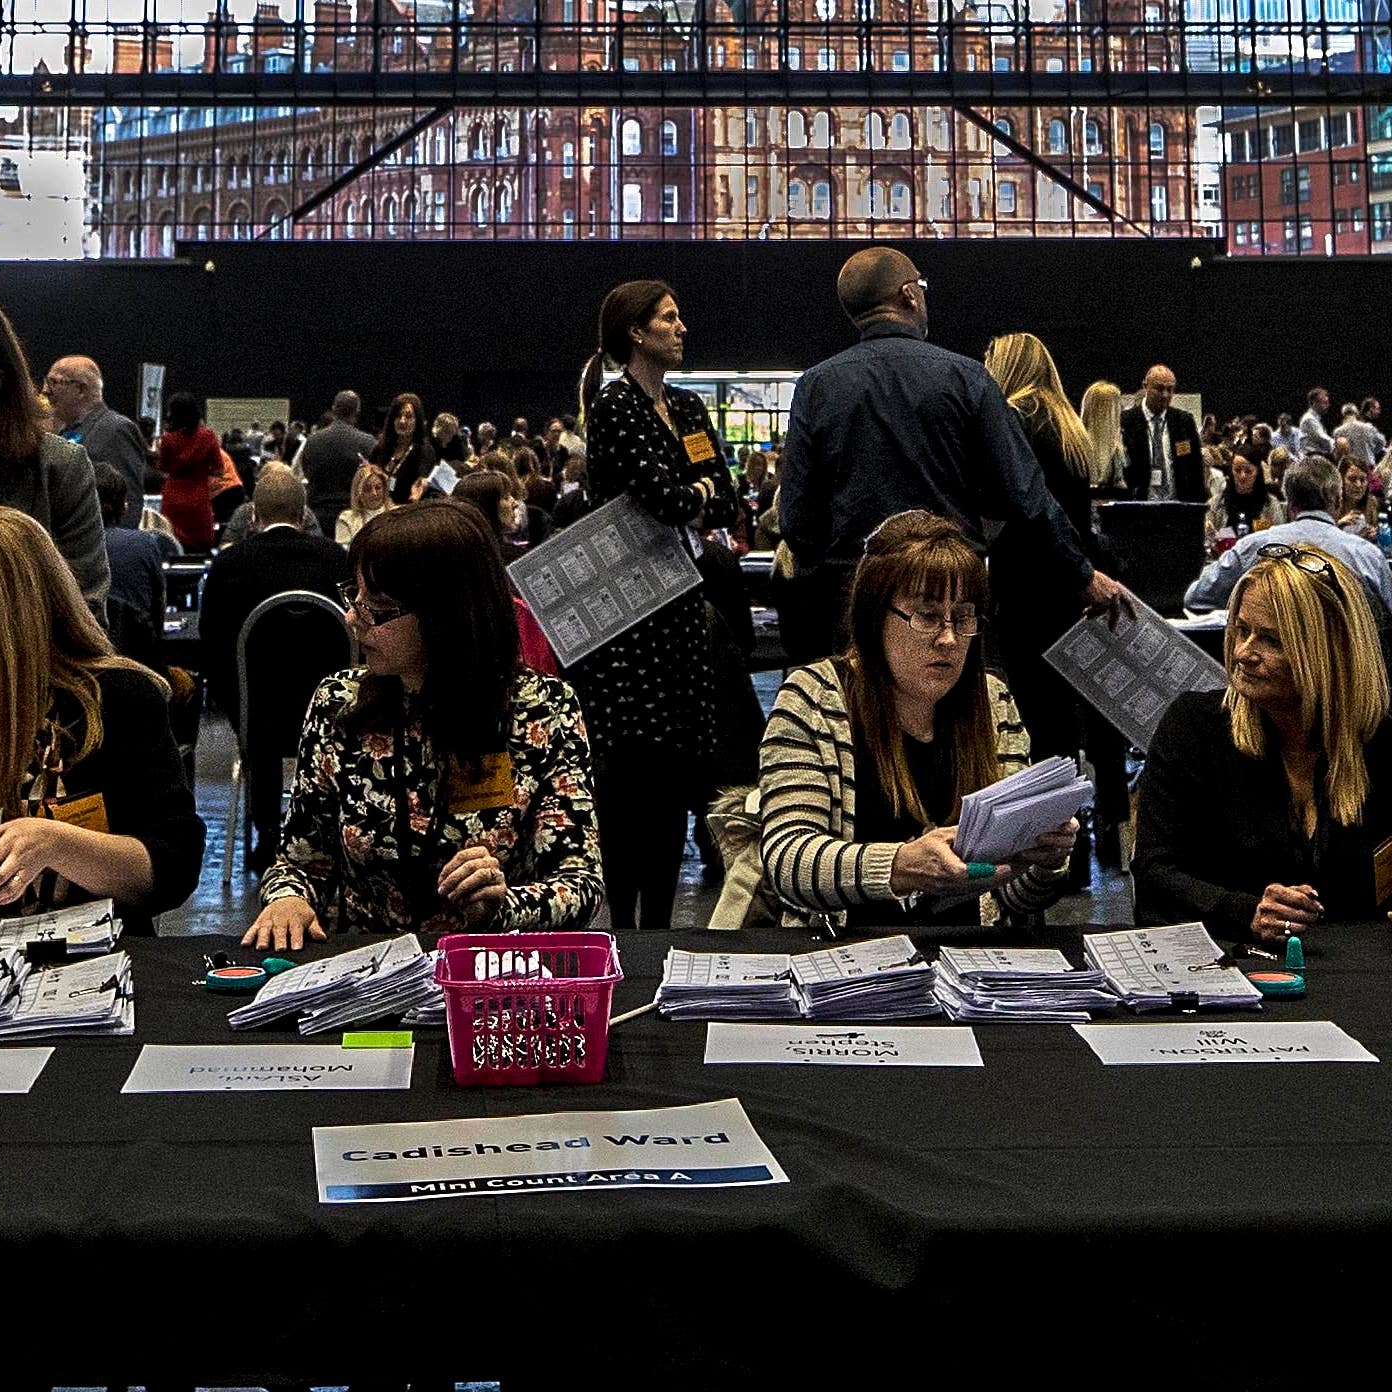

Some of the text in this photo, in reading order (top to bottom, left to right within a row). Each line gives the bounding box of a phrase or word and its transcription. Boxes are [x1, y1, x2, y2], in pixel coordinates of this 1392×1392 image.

[788, 1039, 894, 1048] Stephen
[1197, 1038, 1247, 1046] Will
[785, 1047, 898, 1056] MORRIS,
[1150, 1046, 1309, 1054] PATTERSON,
[341, 1132, 731, 1162] Cadishead Ward
[411, 1171, 692, 1193] Mini Count Area A
